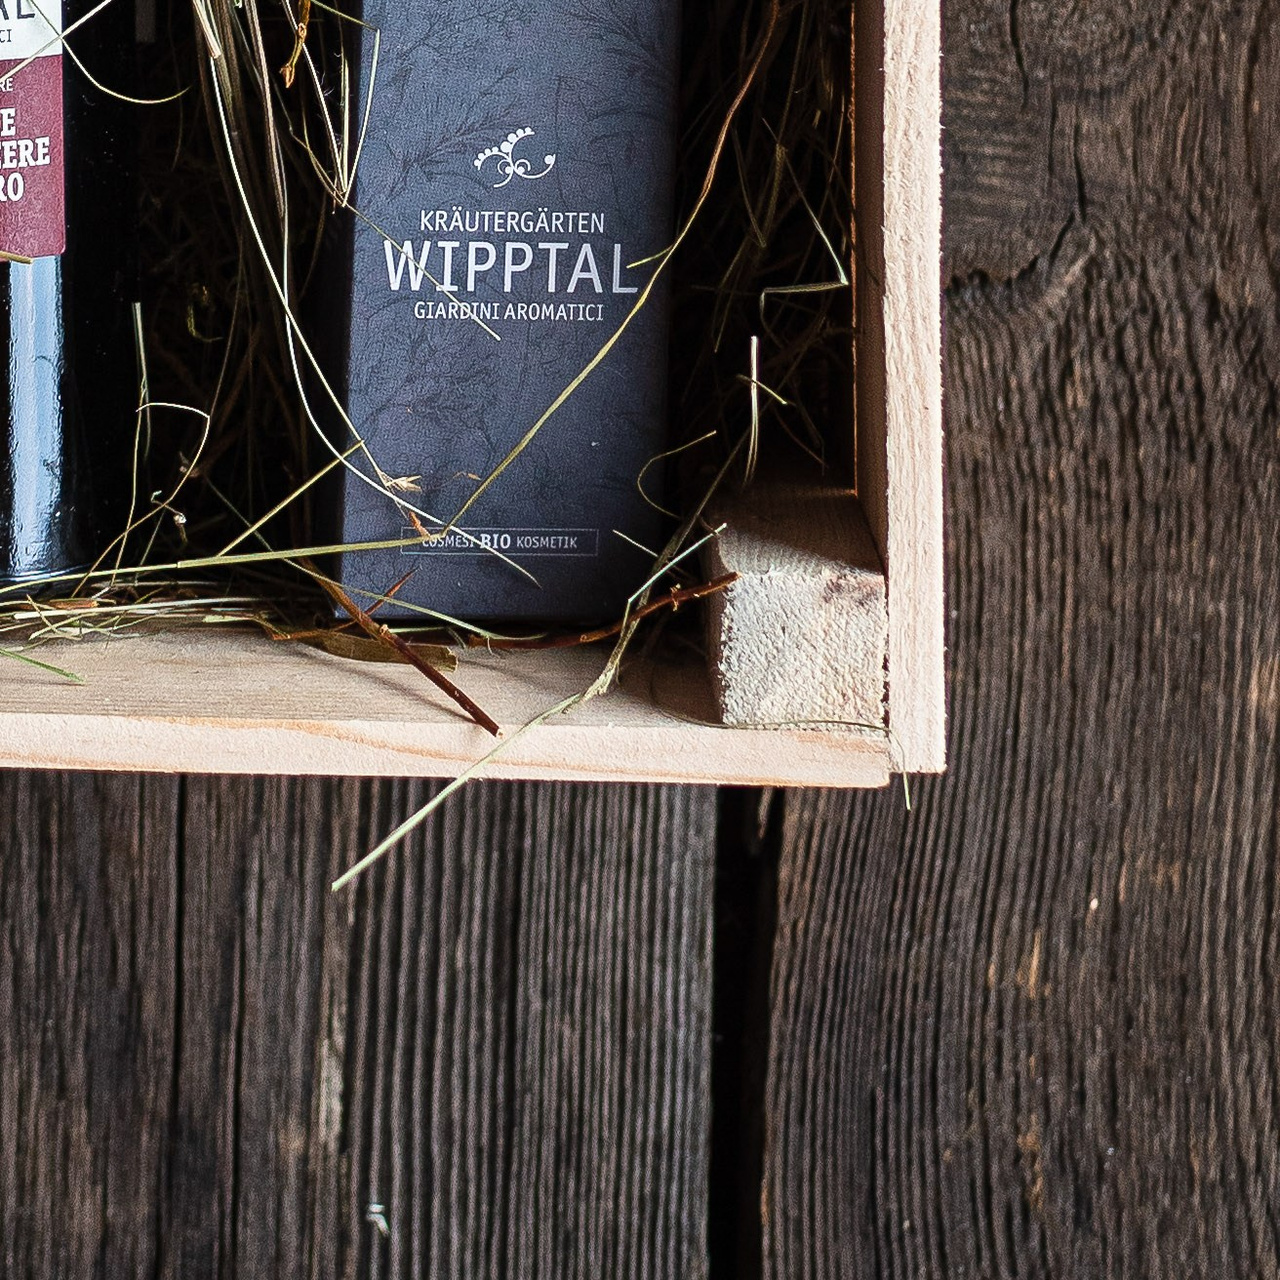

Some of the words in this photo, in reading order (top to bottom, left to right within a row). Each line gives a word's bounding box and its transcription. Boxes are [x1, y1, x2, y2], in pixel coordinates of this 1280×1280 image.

[420, 206, 605, 233] KRÄUTERGÄRTEN
[383, 240, 639, 294] WIPPTAL
[414, 302, 500, 320] GIARDINI
[504, 303, 604, 322] AROMATICI
[480, 533, 510, 549] BIO
[517, 537, 577, 548] KOSMETIK
